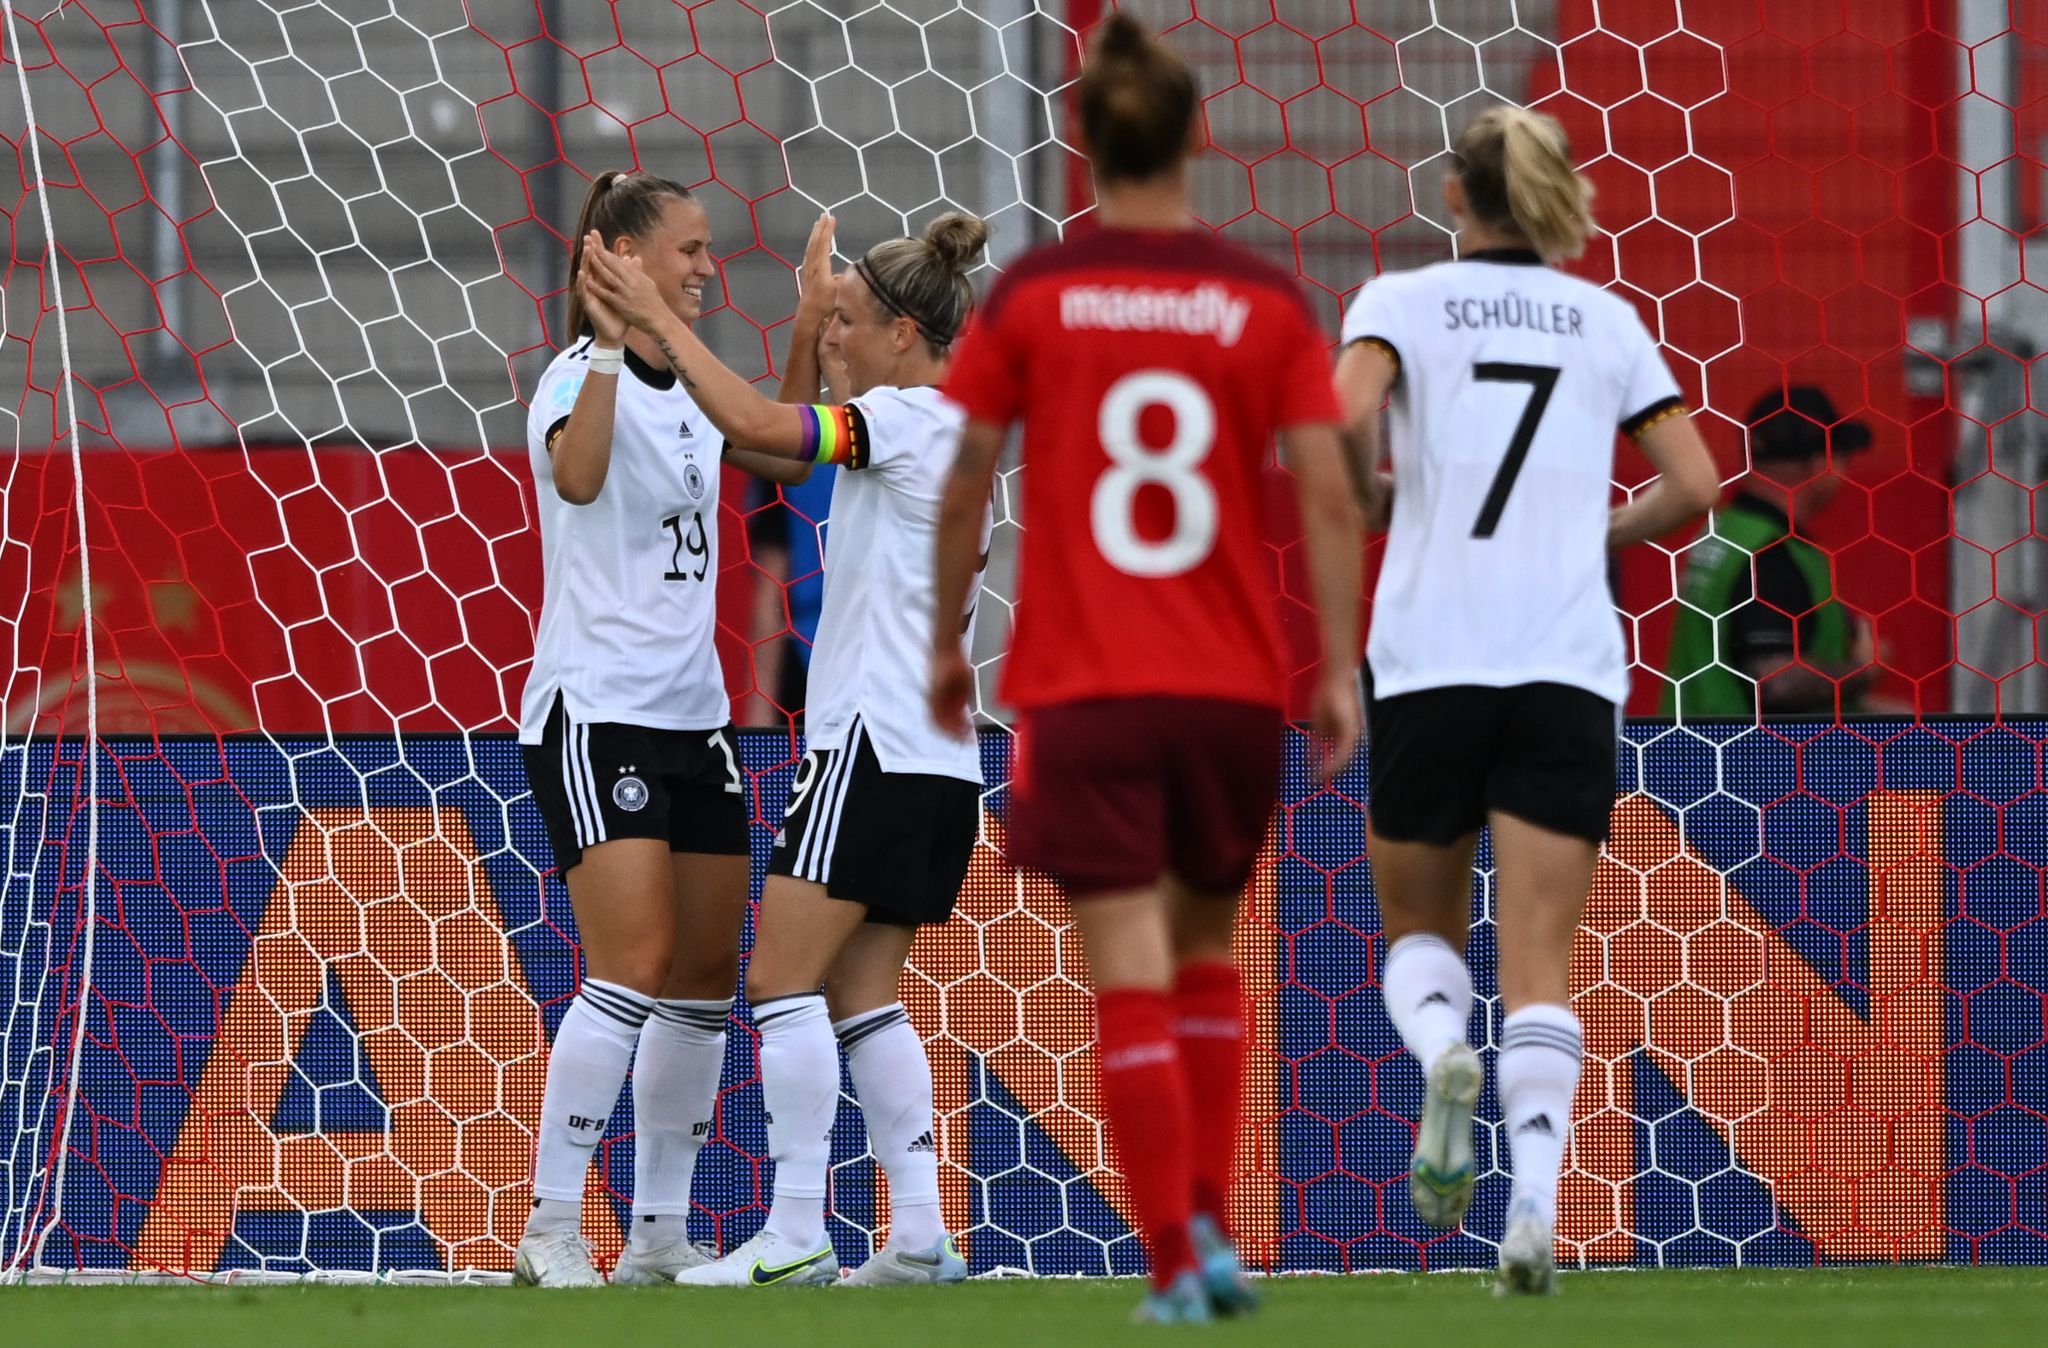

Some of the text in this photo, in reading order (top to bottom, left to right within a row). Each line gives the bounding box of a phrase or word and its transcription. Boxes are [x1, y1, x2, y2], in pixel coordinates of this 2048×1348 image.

[1444, 291, 1584, 337] SCHÜLLER
[1090, 368, 1221, 578] 8
[1470, 362, 1561, 539] 7
[662, 511, 709, 582] 19
[785, 750, 818, 818] 9
[568, 1114, 606, 1131] DFB
